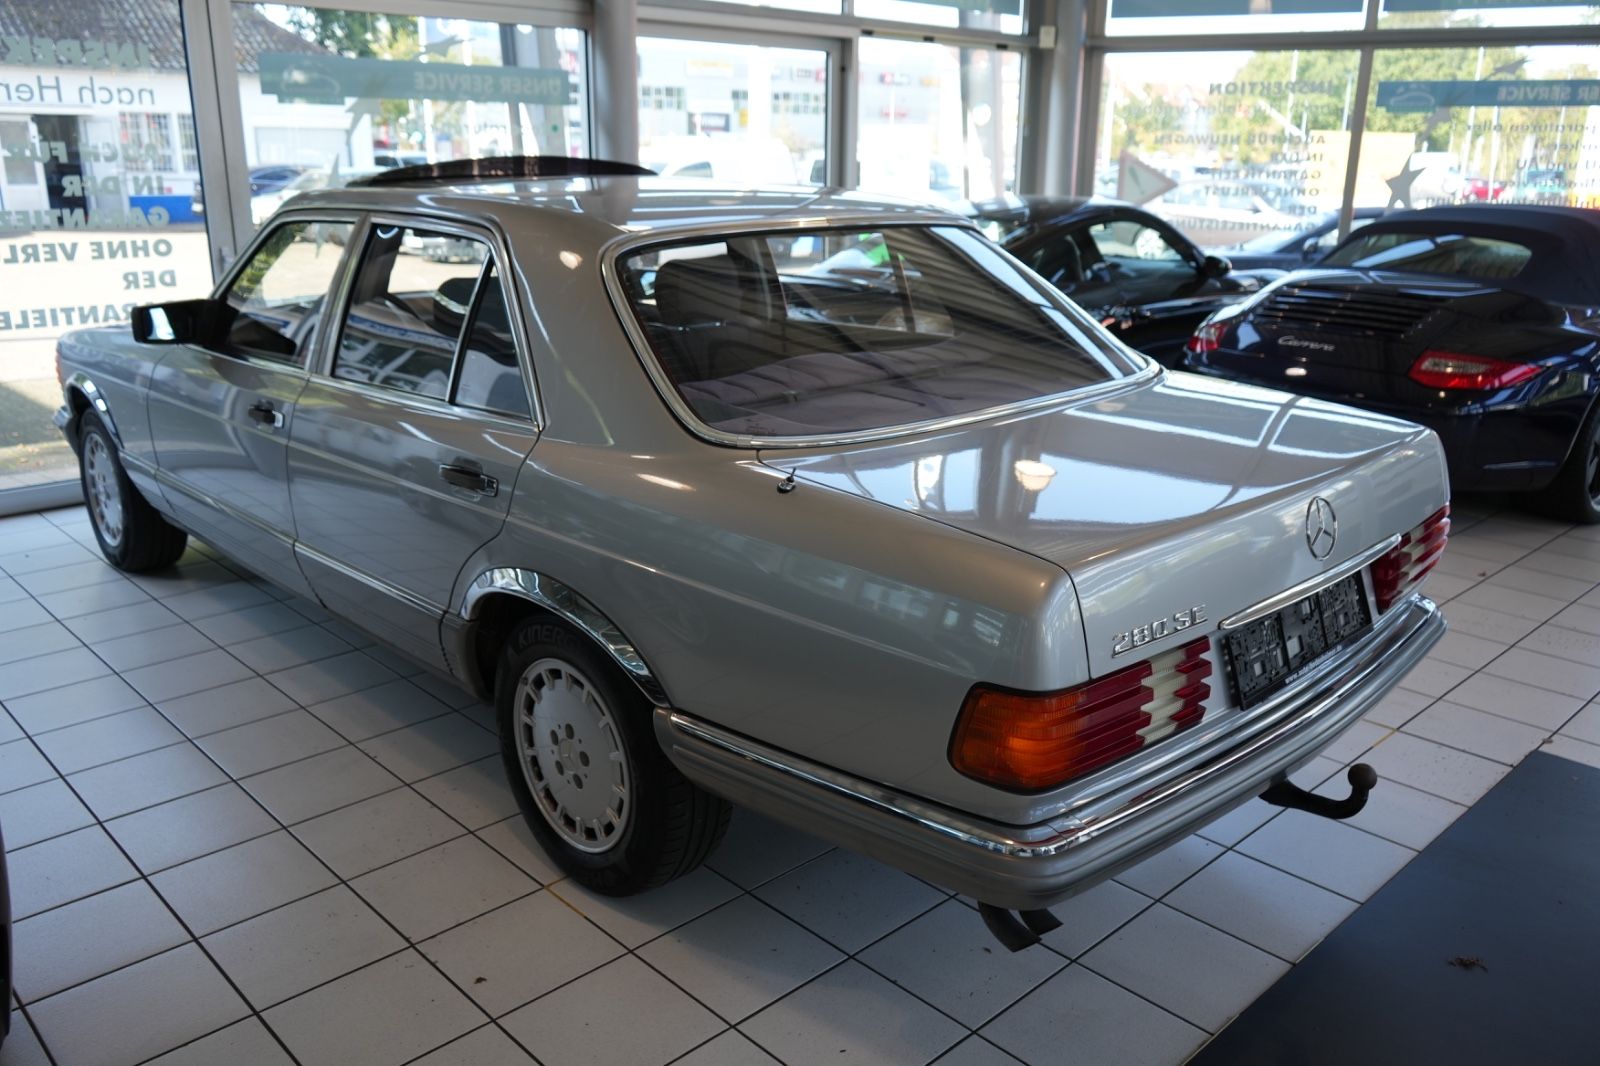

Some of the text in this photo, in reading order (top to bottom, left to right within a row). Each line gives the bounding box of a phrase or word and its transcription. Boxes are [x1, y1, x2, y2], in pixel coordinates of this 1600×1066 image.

[1278, 335, 1335, 352] Carrera
[1111, 603, 1208, 659] 280 SE
